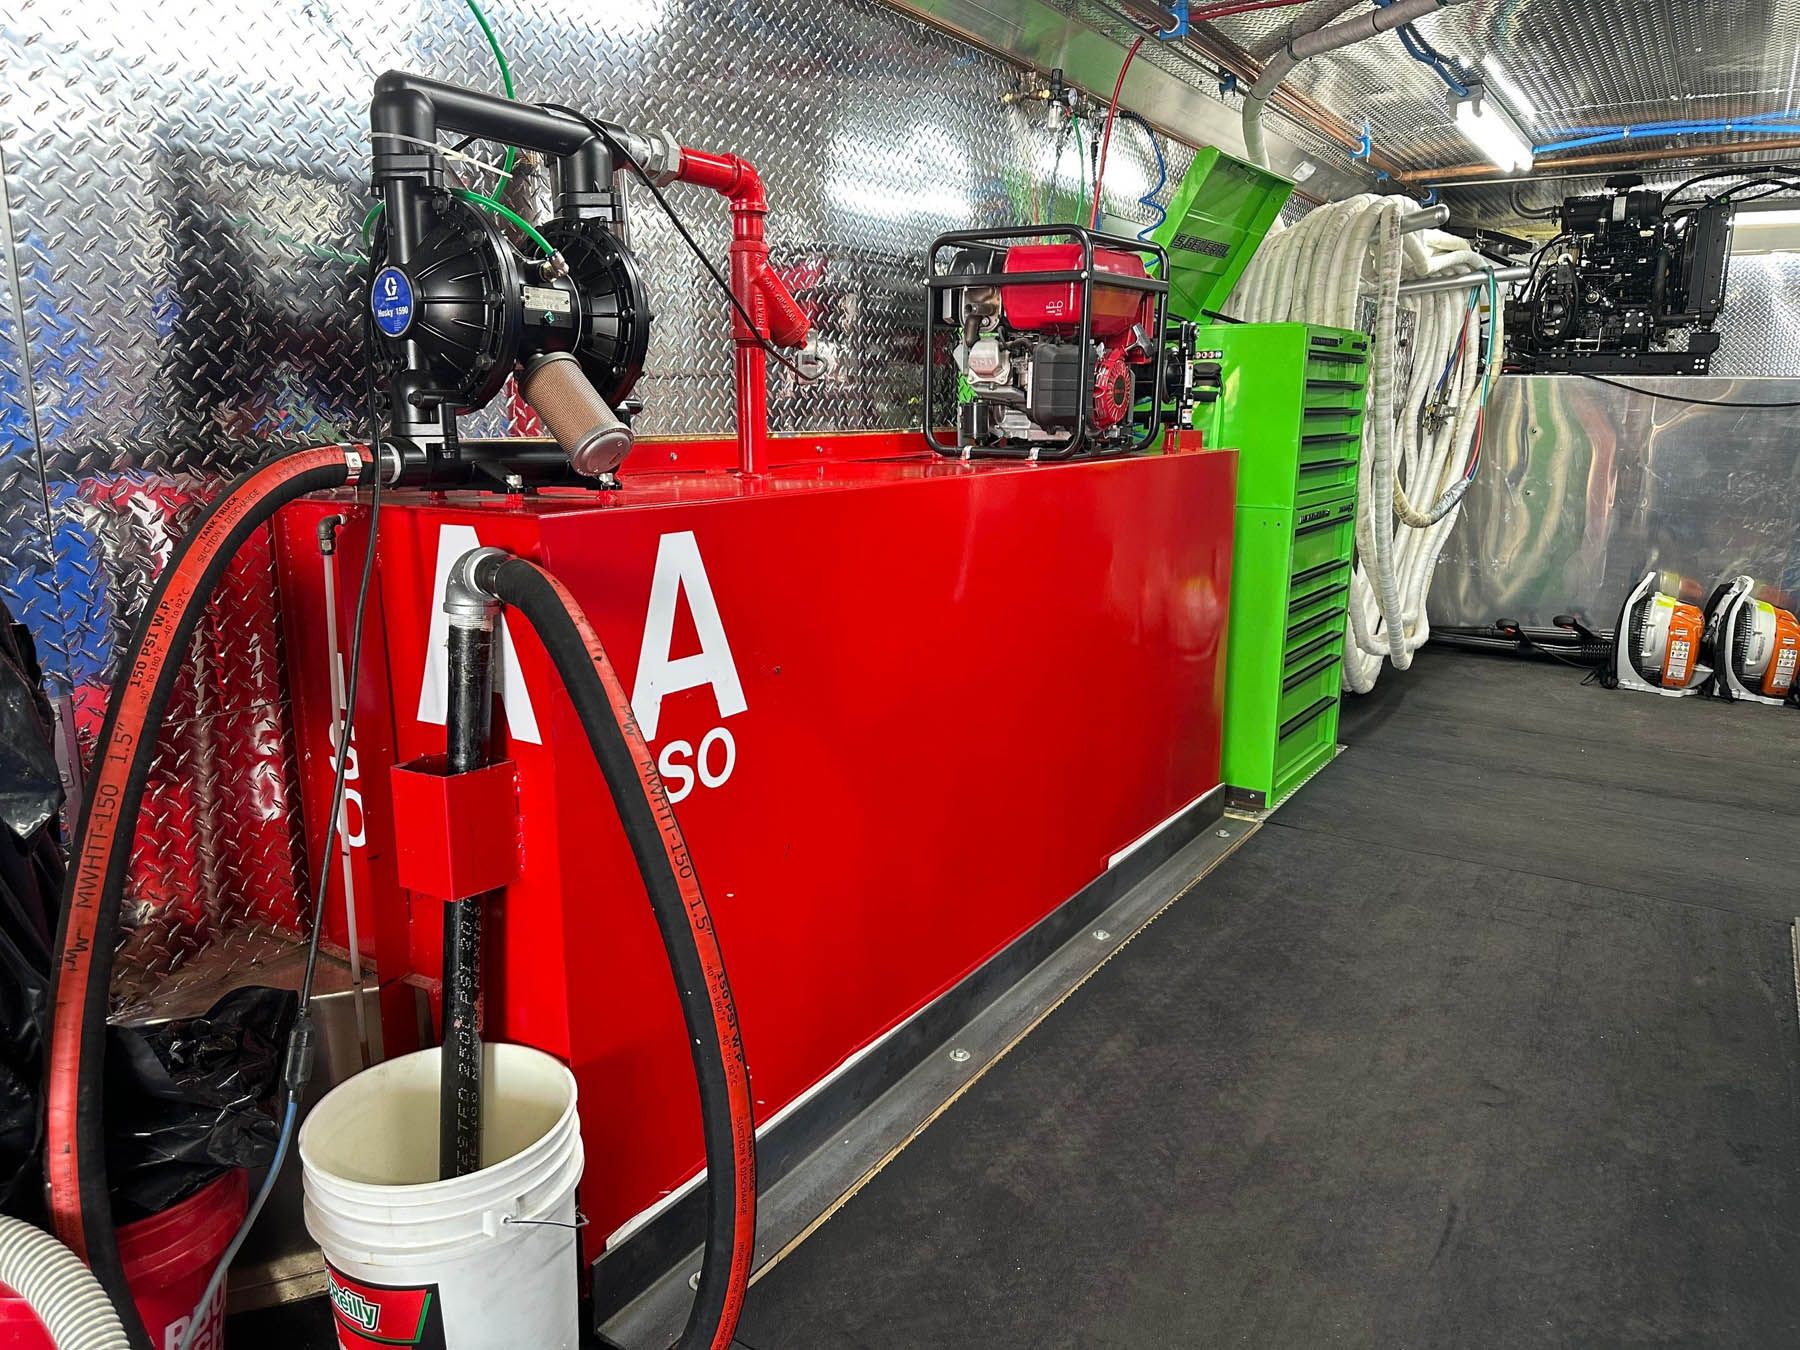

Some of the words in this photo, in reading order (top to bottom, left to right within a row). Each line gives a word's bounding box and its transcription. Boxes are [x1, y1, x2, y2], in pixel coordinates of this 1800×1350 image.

[377, 308, 394, 318] Husky
[395, 305, 409, 315] 1590
[195, 529, 225, 564] SUCTION
[224, 485, 260, 527] DISCHARGE
[198, 518, 219, 542] TANK
[216, 493, 239, 521] TRUCK
[128, 659, 150, 688] 150
[139, 630, 160, 658] PSI
[630, 530, 748, 742] A
[657, 727, 736, 804] SO
[458, 961, 473, 1005] PSI
[716, 970, 730, 1000] 150
[723, 1003, 737, 1030] PSI
[737, 1116, 746, 1155] SUCTION
[739, 1167, 747, 1216] DISCHARGE
[328, 1274, 378, 1329] Reilly
